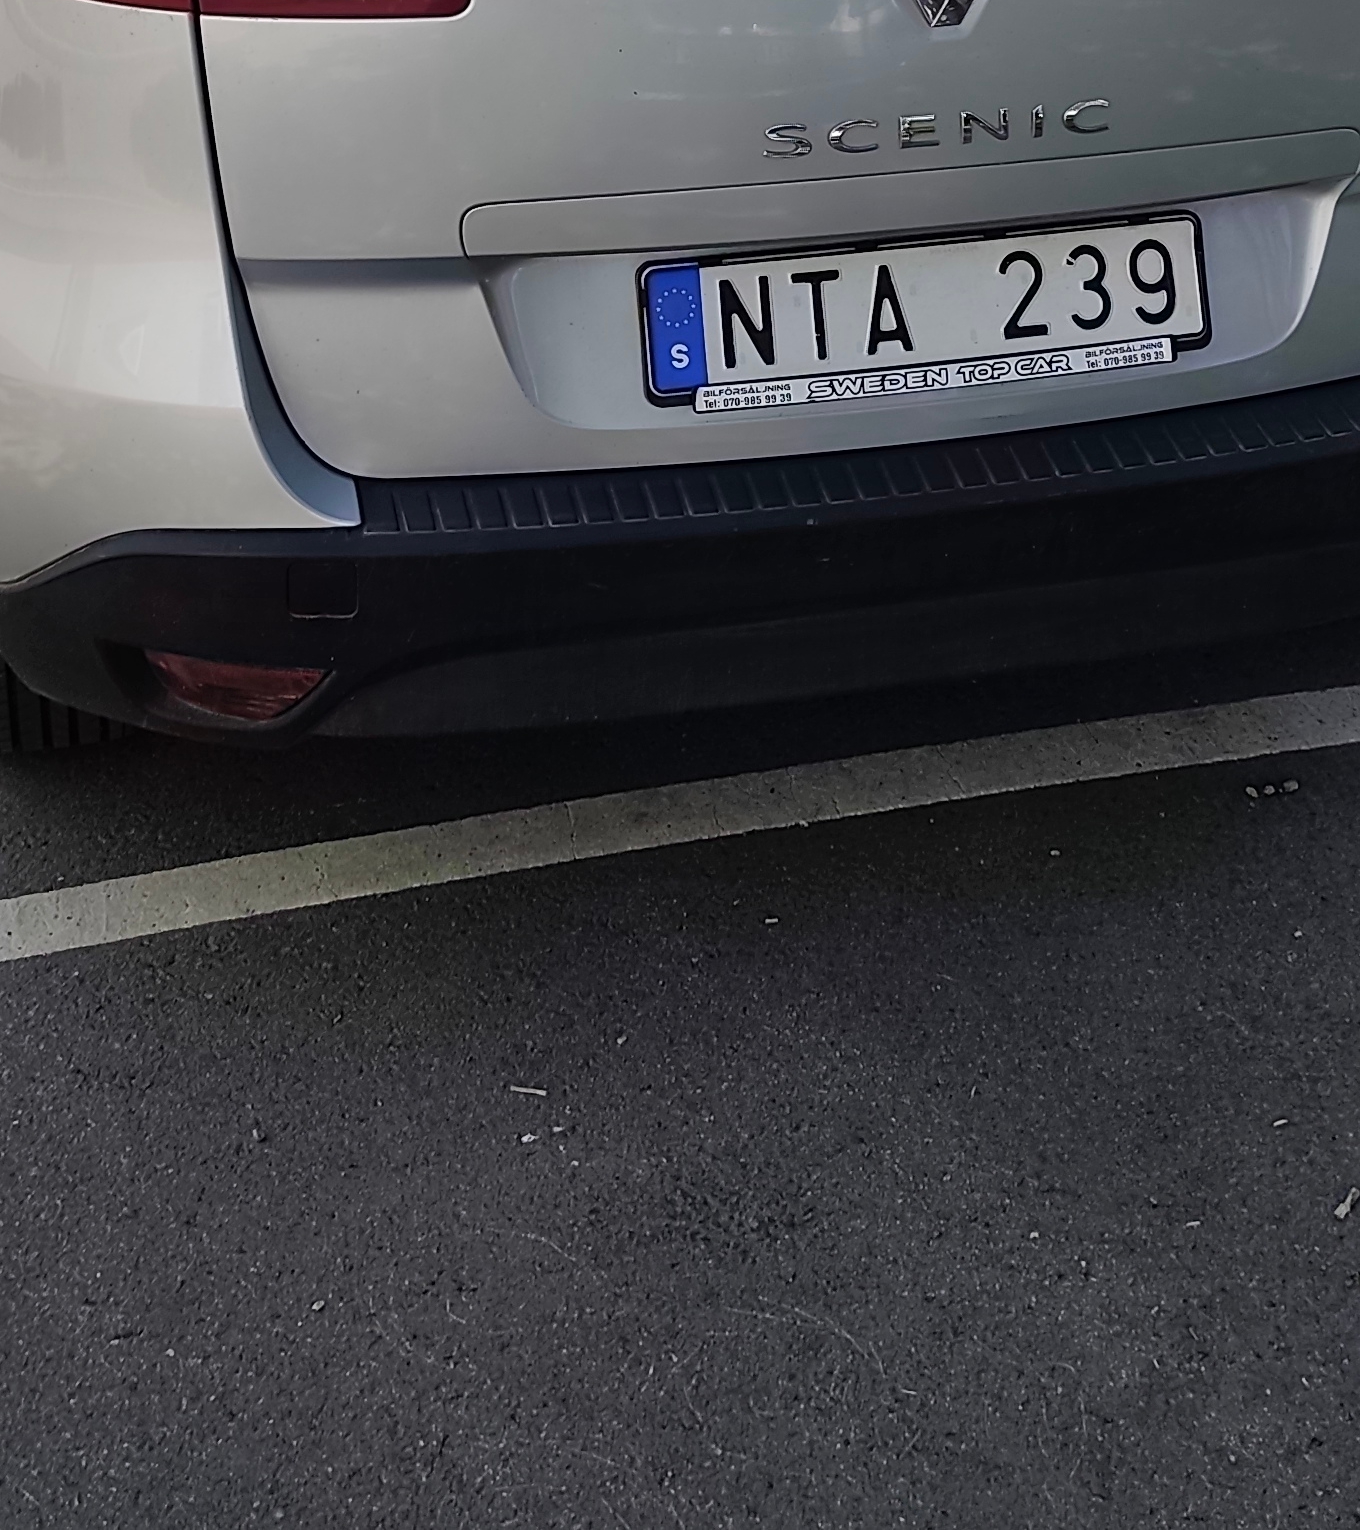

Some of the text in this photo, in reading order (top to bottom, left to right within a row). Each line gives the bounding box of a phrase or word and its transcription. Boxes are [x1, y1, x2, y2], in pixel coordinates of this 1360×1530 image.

[762, 99, 1110, 159] SCENIC
[718, 238, 1177, 369] NTA 239
[670, 343, 690, 369] S
[1086, 350, 1165, 369] Tel: 070-985 99 39
[806, 353, 1073, 400] SWEDEN TOP CAR
[704, 392, 792, 409] Tel: 070-985 99 39
